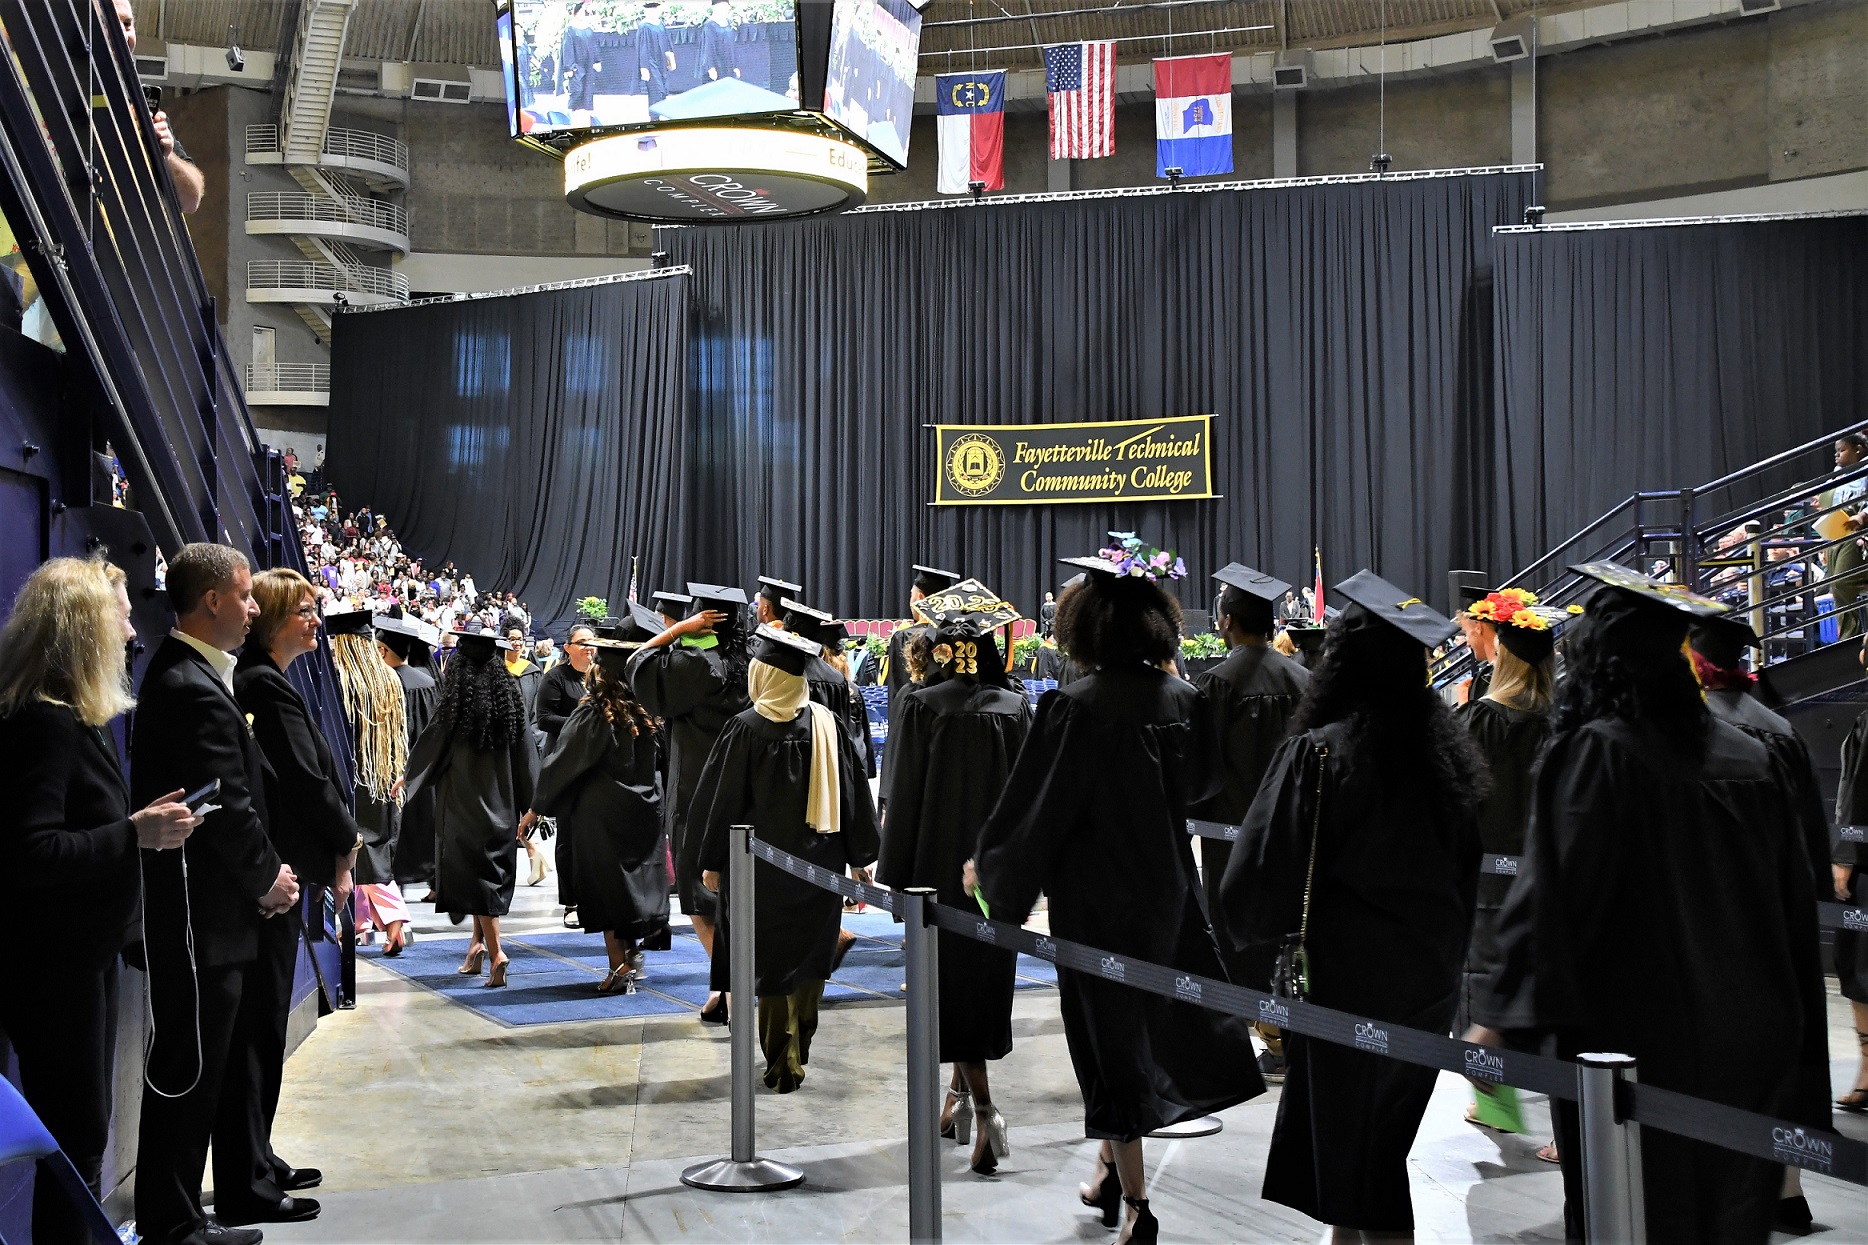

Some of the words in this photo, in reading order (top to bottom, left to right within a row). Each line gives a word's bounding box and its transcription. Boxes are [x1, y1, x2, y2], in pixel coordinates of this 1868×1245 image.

[643, 179, 728, 217] COMPLEX
[689, 174, 788, 214] CROWN
[1013, 438, 1112, 469] Fayetteville
[1113, 425, 1201, 461] Technical
[1020, 466, 1127, 495] Community
[1130, 464, 1193, 494] College
[955, 641, 977, 658] 20
[955, 658, 978, 674] 23
[1840, 827, 1864, 835] CROWN
[1495, 858, 1517, 867] CROWN
[1843, 910, 1868, 922] CROW
[1101, 957, 1125, 972] CROWN
[1175, 977, 1202, 993] CROWN
[1259, 1000, 1289, 1017] CROWN
[1354, 1023, 1388, 1041] CROWN
[1464, 1049, 1503, 1069] CROWN
[1772, 1127, 1832, 1156] CROWN
